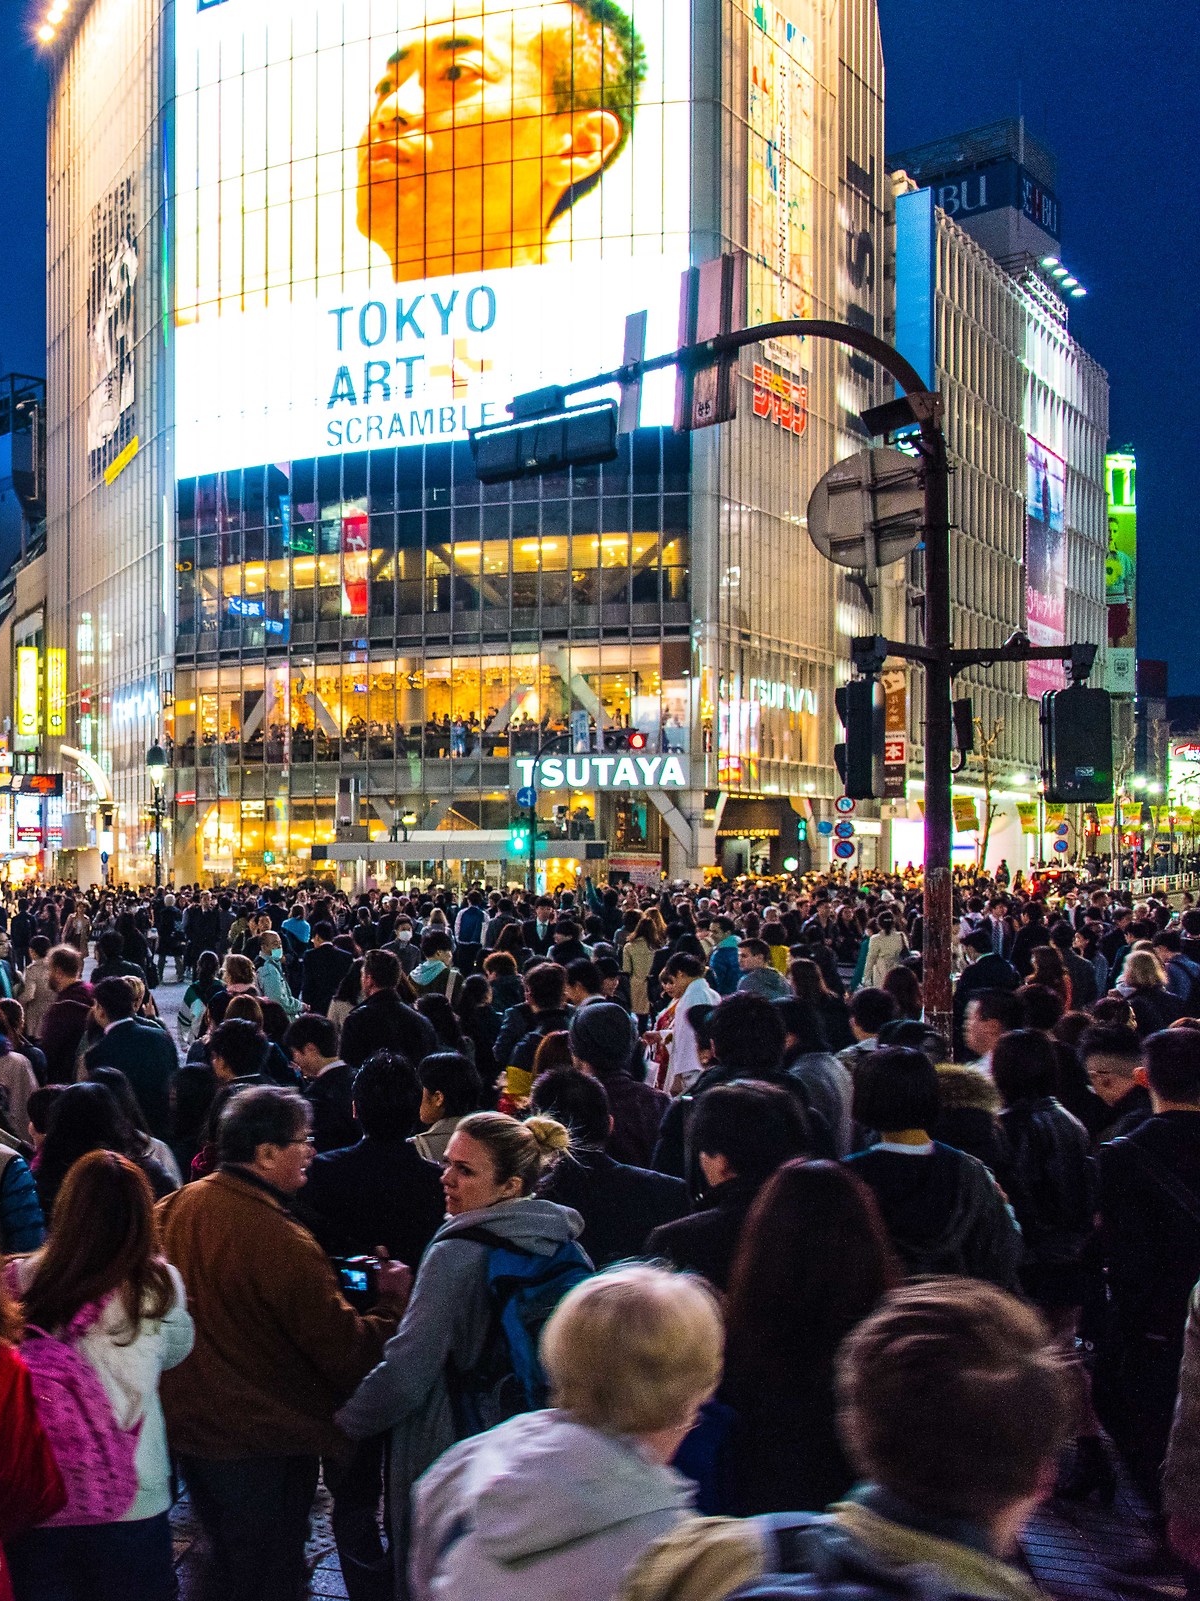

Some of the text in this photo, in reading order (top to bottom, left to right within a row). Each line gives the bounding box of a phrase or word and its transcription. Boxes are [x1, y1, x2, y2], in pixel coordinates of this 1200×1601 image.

[328, 285, 497, 351] TOKYO
[327, 354, 425, 409] ART
[326, 402, 496, 447] SCRAMBLE
[516, 756, 686, 788] TSUTAYA
